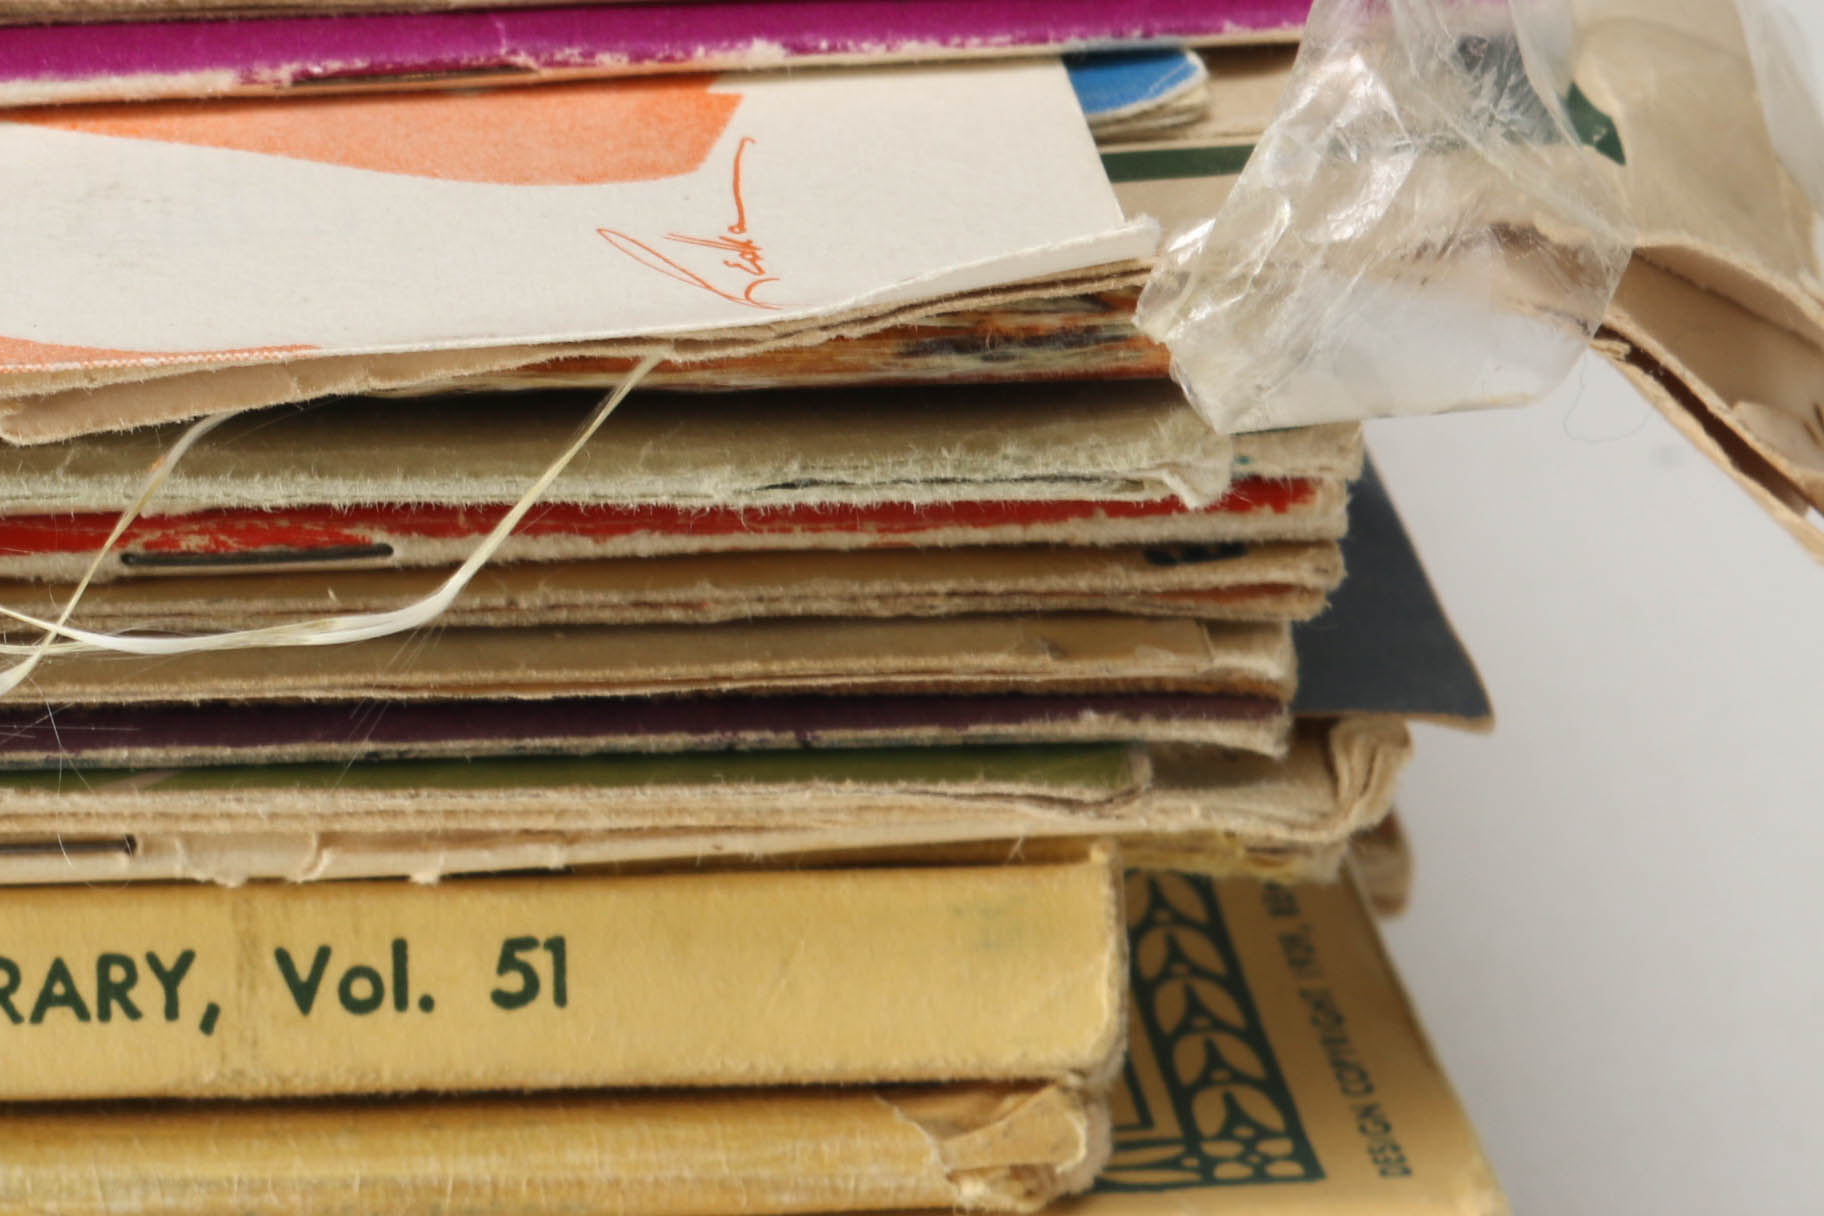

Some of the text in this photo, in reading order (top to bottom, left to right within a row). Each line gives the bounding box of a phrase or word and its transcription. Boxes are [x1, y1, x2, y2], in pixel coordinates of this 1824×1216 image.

[273, 937, 436, 1017] Vol.
[489, 934, 569, 1012] 51
[1298, 985, 1375, 1098] COPYRIGHT
[1351, 1102, 1413, 1179] DESIGN
